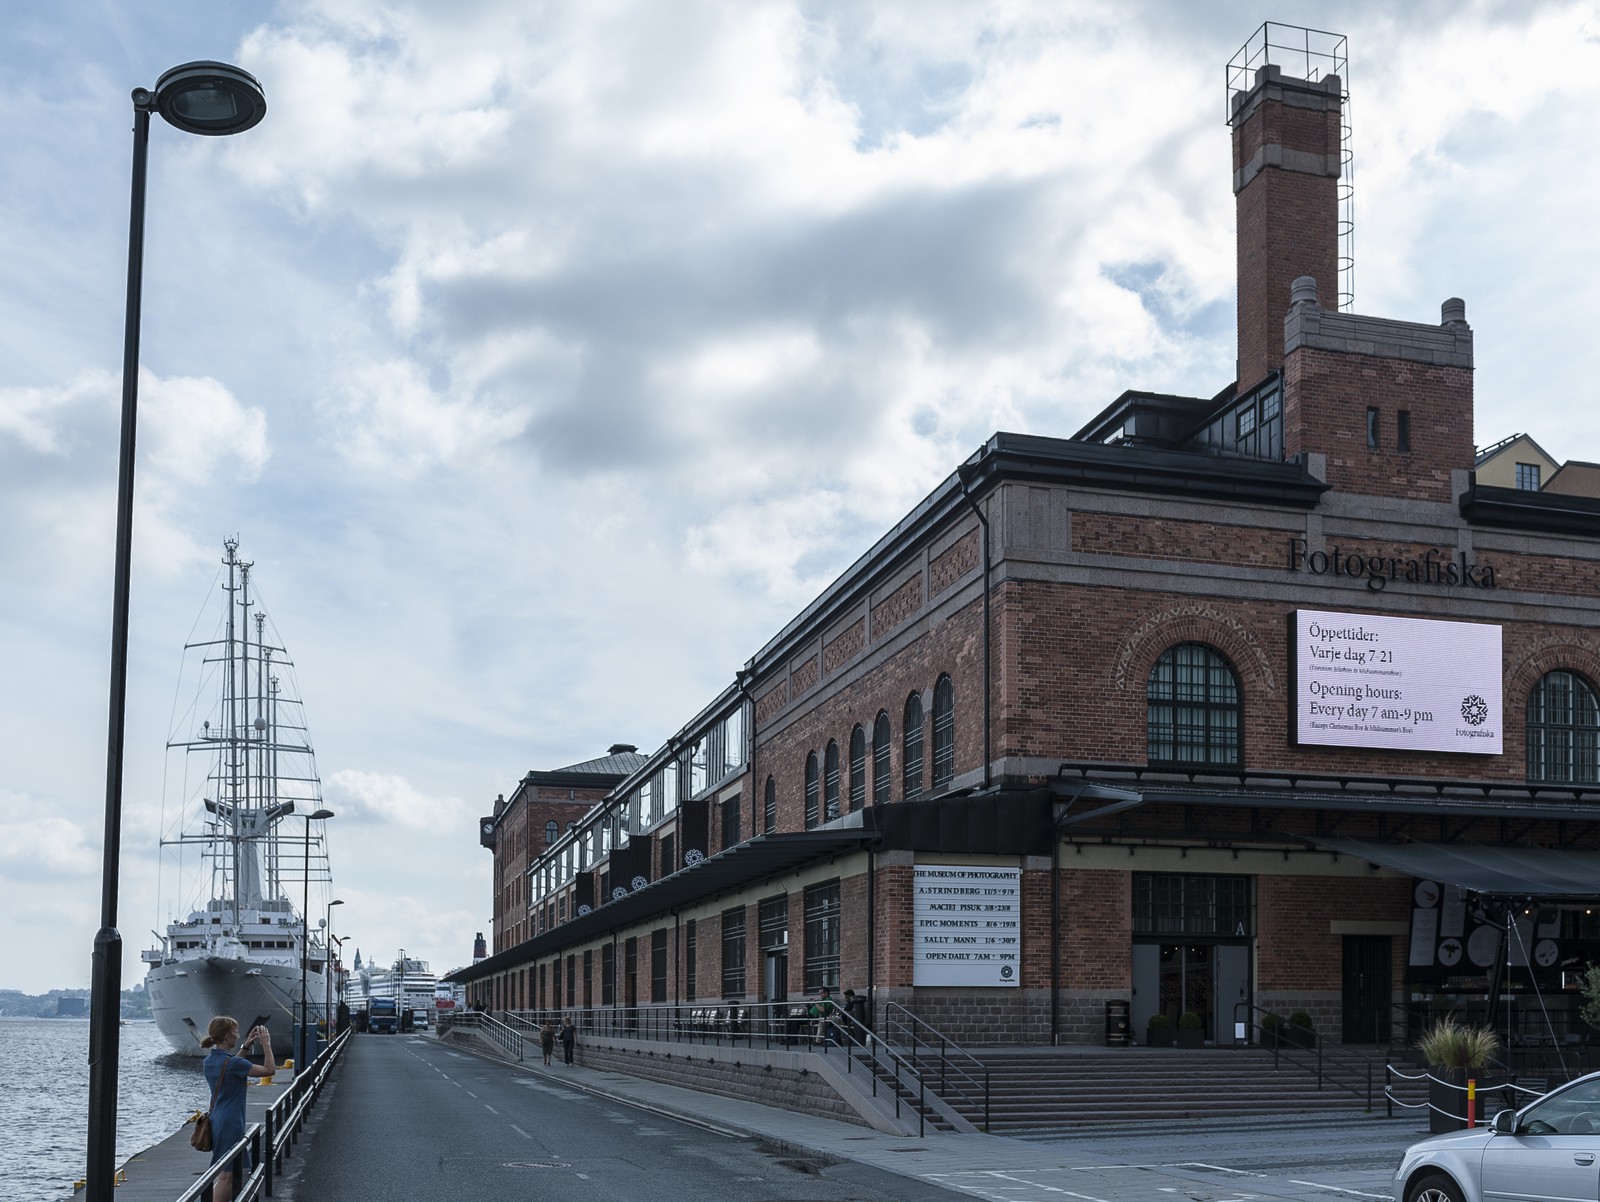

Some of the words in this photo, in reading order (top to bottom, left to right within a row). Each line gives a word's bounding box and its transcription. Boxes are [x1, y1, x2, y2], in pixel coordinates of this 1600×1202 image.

[1288, 537, 1497, 591] Fotografiska
[1309, 621, 1379, 642] Öppettider:
[1310, 645, 1341, 663] Varje
[1344, 647, 1366, 665] dag
[1368, 649, 1393, 663] 7-21
[1309, 680, 1363, 701] Opening
[1365, 684, 1402, 700] hours:
[1309, 701, 1344, 720] Every
[1346, 703, 1369, 721] day
[1371, 706, 1378, 719] 7
[1414, 710, 1434, 725] pm
[927, 870, 957, 878] MUSEUM
[919, 919, 938, 927] EPIC
[1235, 921, 1245, 936] A
[925, 952, 947, 960] OPEN
